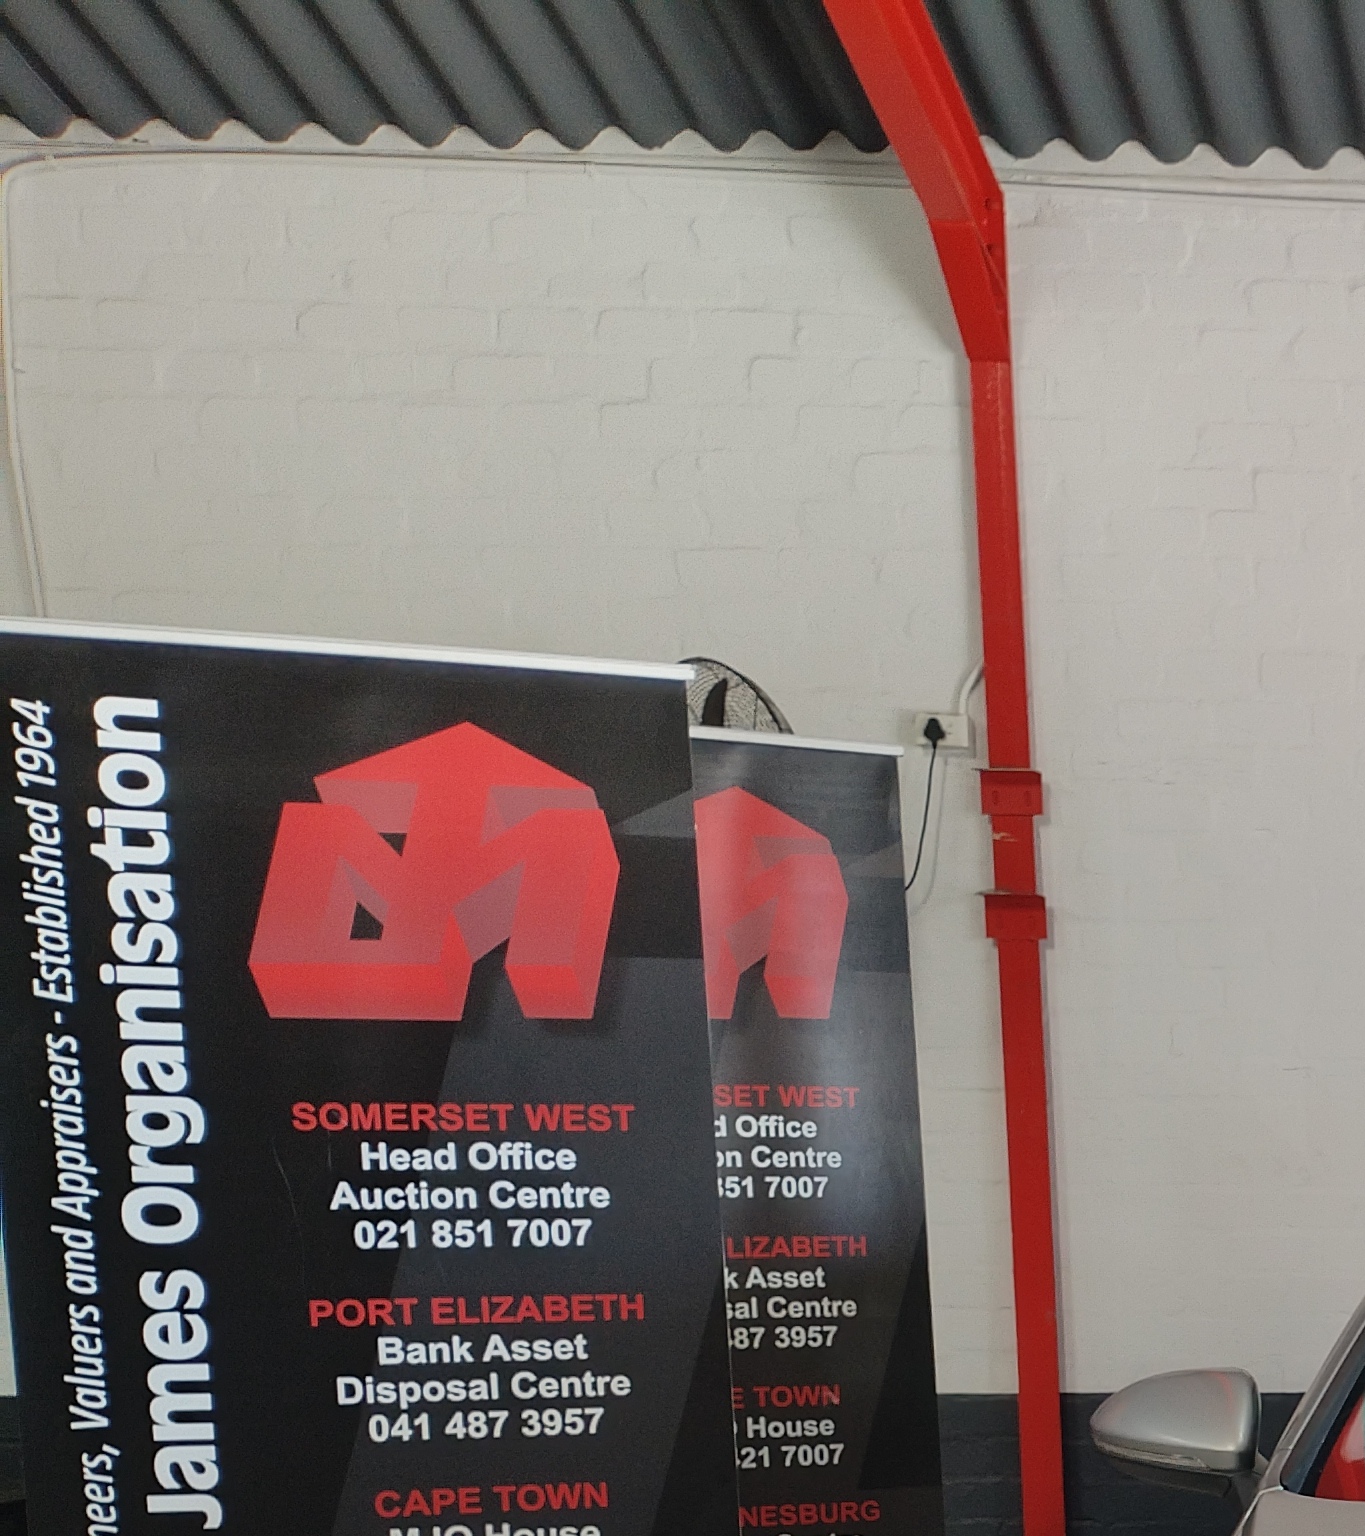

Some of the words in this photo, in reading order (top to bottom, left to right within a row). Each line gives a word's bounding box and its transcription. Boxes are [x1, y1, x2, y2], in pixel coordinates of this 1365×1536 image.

[11, 698, 56, 787] 1964
[15, 796, 73, 1002] Established
[87, 696, 204, 1244] Organisation
[778, 1085, 859, 1107] WEST
[40, 1033, 99, 1220] Appraisers
[292, 1102, 513, 1131] SOMERSET
[524, 1104, 634, 1131] WEST
[735, 1115, 817, 1138] Office
[361, 1142, 456, 1171] Head
[468, 1142, 576, 1170] Office
[751, 1146, 842, 1168] Centre
[330, 1181, 477, 1210] Auction
[489, 1181, 610, 1209] Centre
[765, 1176, 828, 1198] 7007
[354, 1220, 416, 1249] 021
[432, 1219, 492, 1248] 851
[507, 1219, 592, 1247] 7007
[727, 1236, 866, 1258] LIZABETH
[51, 1225, 97, 1294] and
[746, 1266, 825, 1288] Asset
[309, 1298, 418, 1327] PORT
[431, 1294, 644, 1324] ELIZABETH
[767, 1296, 857, 1318] Centre
[378, 1335, 474, 1365] Bank
[483, 1334, 588, 1362] Asset
[775, 1326, 837, 1348] 3957
[64, 1304, 108, 1429] Valuers
[139, 1270, 222, 1529] James
[337, 1372, 499, 1409] Disposal
[511, 1371, 631, 1399] Centre
[753, 1385, 840, 1407] TOWN
[369, 1413, 430, 1442] 041
[445, 1410, 509, 1439] 487
[521, 1407, 604, 1437] 3957
[747, 1416, 834, 1438] House
[781, 1443, 844, 1466] 7007
[375, 1487, 482, 1518] CAPE
[493, 1482, 608, 1511] TOWN
